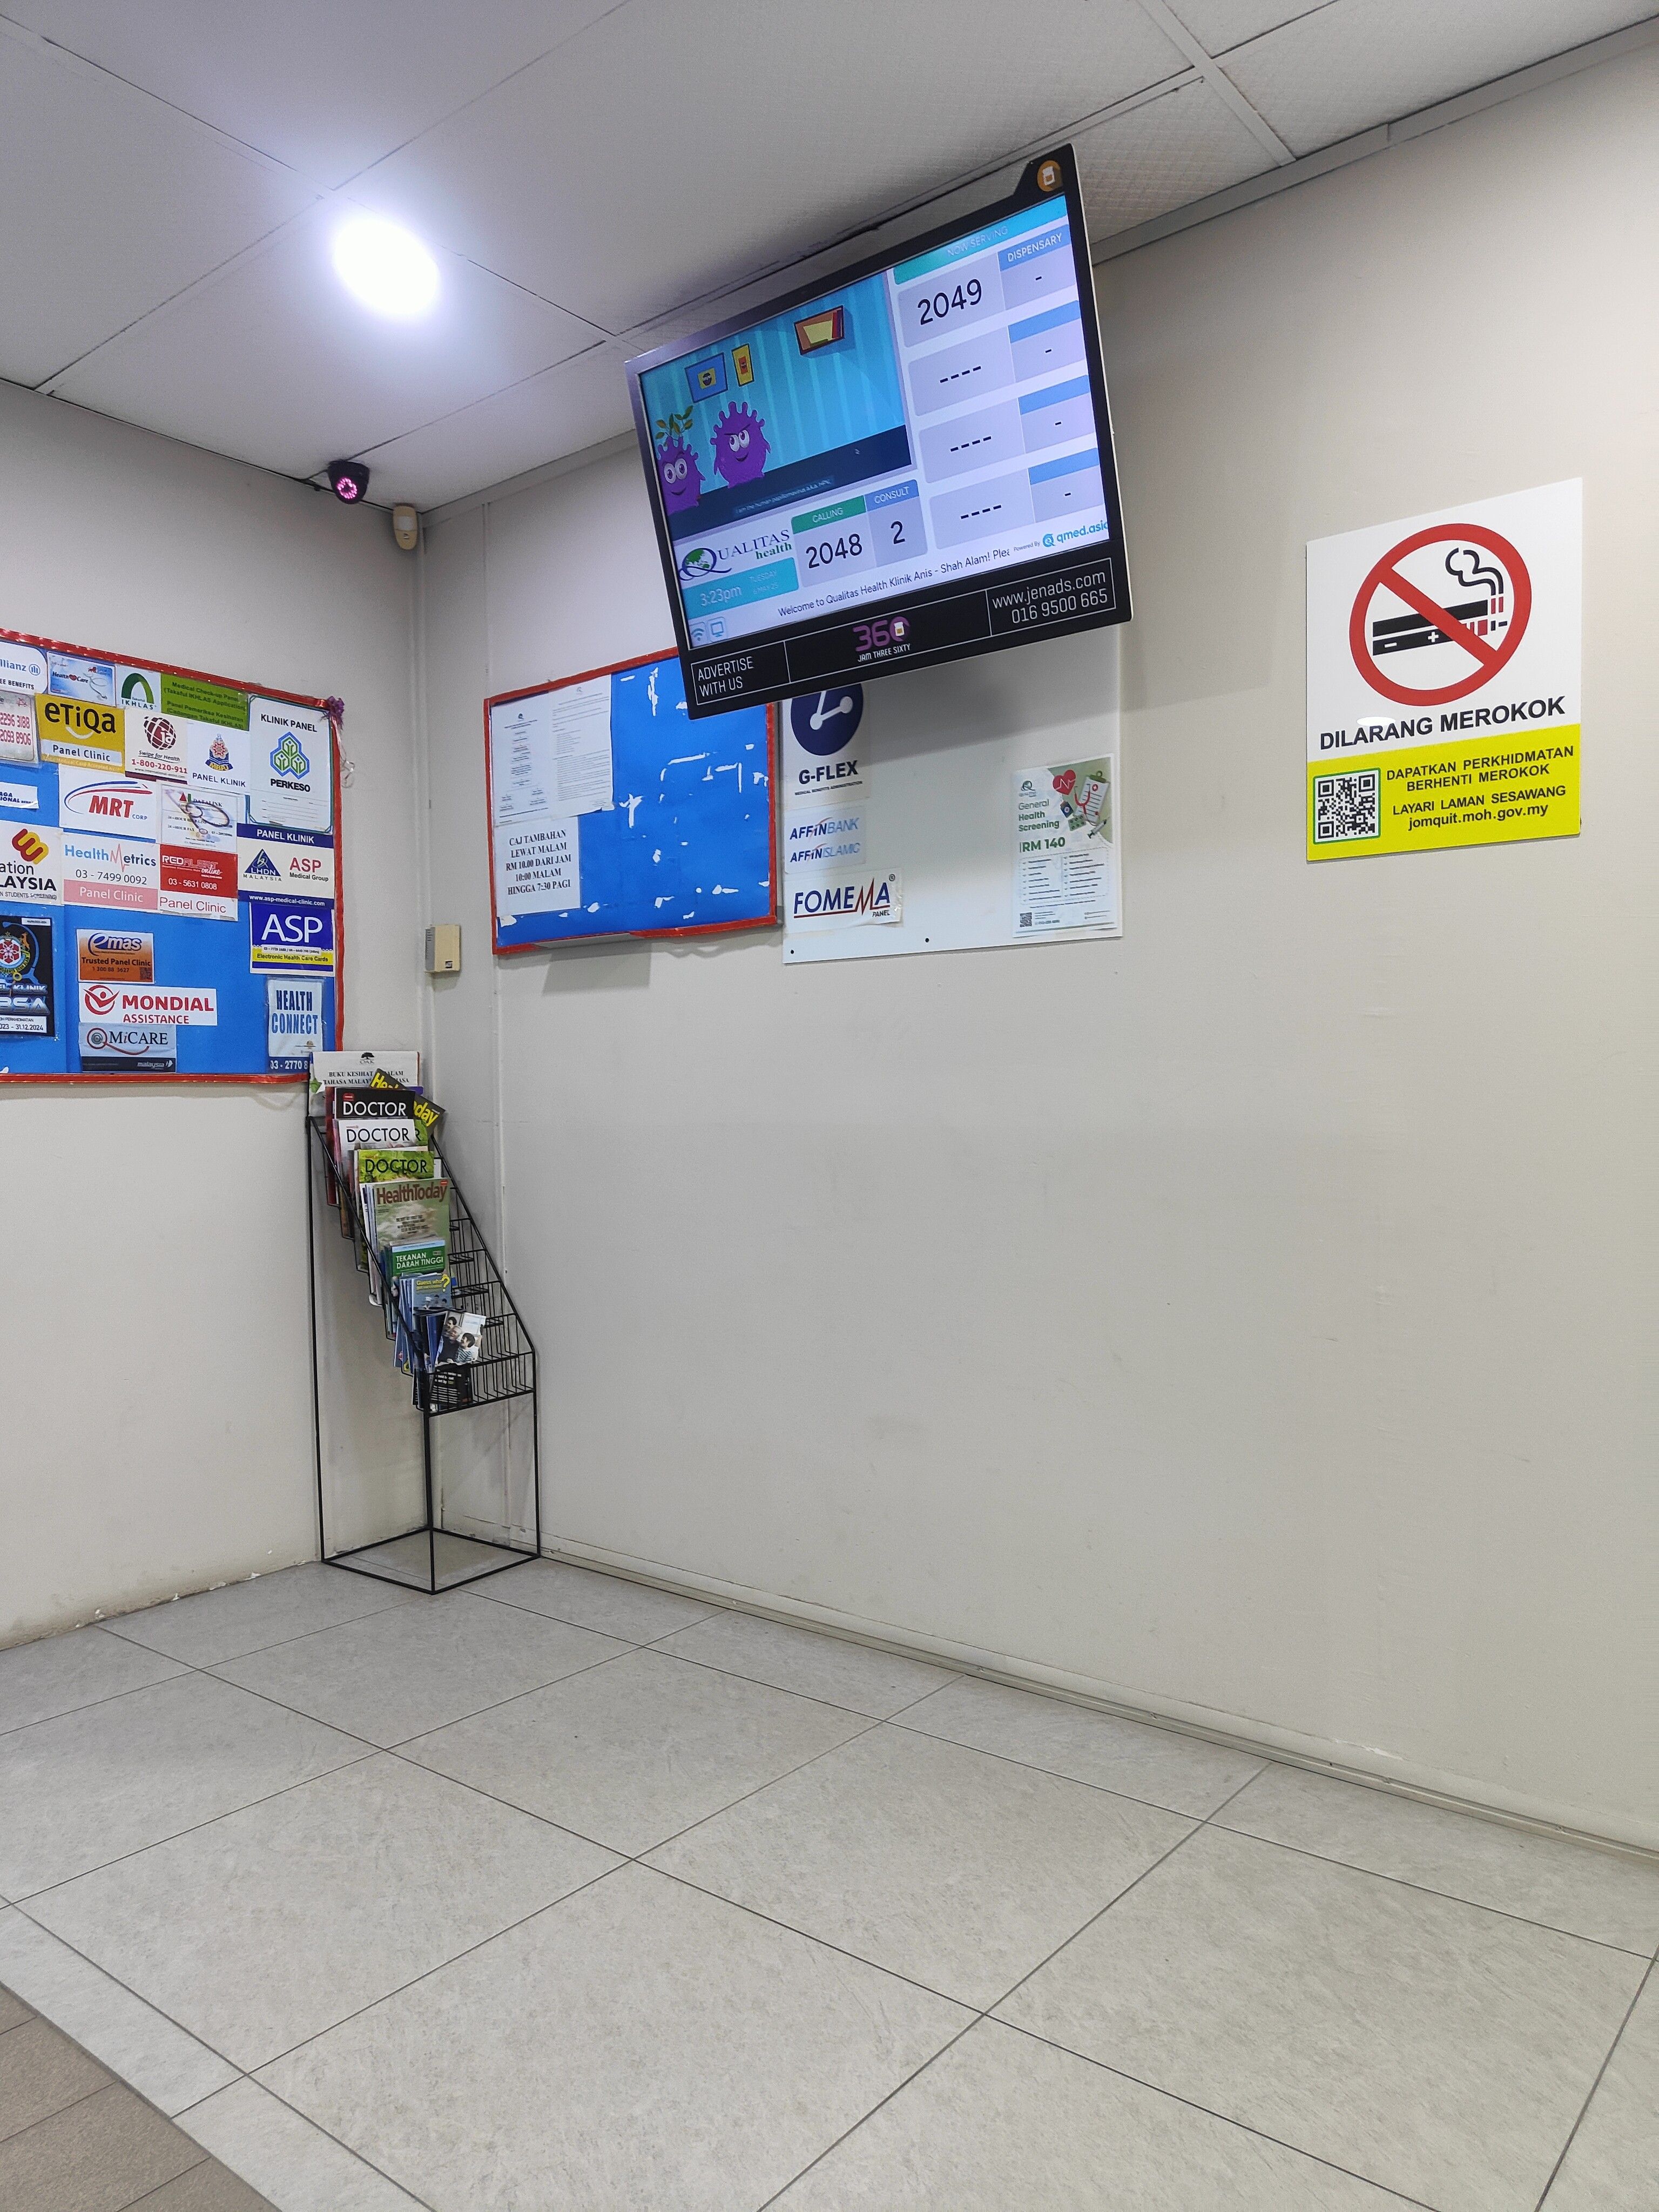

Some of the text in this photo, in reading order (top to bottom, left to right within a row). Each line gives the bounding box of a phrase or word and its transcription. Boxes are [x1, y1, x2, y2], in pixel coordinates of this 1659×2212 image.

[947, 226, 1008, 257] NOW SERVING
[1007, 233, 1062, 263] DISPENSARY
[917, 279, 982, 325] 2049
[874, 486, 910, 504] CONSULT
[812, 507, 843, 524] CALLING
[890, 520, 906, 544] 2
[679, 529, 790, 581] QUALITAS
[756, 542, 792, 559] health
[805, 533, 863, 569] 2048
[777, 552, 990, 617] Welcome to Qualitas Health Klinik Anis Shah Alam!
[992, 569, 1107, 610] www.jenads.com
[700, 585, 742, 608] 3:23pm
[1011, 589, 1108, 625] 016 9500 665
[857, 643, 911, 663] JAM THREE SIXTY
[52, 671, 69, 679] Health
[697, 656, 754, 682] ADVERTISE
[8, 679, 35, 690] BENEFITS
[172, 682, 195, 692] Medical
[699, 676, 743, 698] WITH US
[122, 699, 154, 710] IKHLAS
[166, 700, 184, 709] Panel
[260, 713, 318, 733] KLINIK PANEL
[1320, 695, 1566, 751] DILARANG MEROKOK
[16, 731, 31, 746] 8906
[52, 744, 111, 762] Panel Clinic
[131, 758, 188, 774] 1-800-220-911
[1386, 745, 1574, 781] DAPATKAN PERKHIDMATAN
[192, 772, 219, 783] PANEL
[220, 777, 246, 788] KLINIK
[799, 759, 859, 785] G-FLEX
[1406, 764, 1550, 792] BERHENTI MEROKOK
[270, 778, 312, 793] PERKESO
[88, 795, 134, 819] MRT
[1018, 798, 1050, 811] General
[1392, 785, 1567, 816] LAYARI LAMAN SESAWANG
[1018, 811, 1046, 822] Health
[1407, 803, 1549, 832] jomquit.moh.gov.my
[1018, 820, 1060, 832] Screening
[257, 829, 315, 844] PANEL KLINIK
[509, 829, 567, 846] CAJ TAMBAHAN
[1021, 836, 1066, 853] RM 140
[64, 843, 157, 873] HealthMetrics
[510, 841, 568, 858] LEWAT MALAM
[0, 860, 34, 875] ation
[201, 864, 223, 875] online
[289, 857, 321, 873] ASP
[505, 854, 572, 871] RM 10.00 DARI JAM
[75, 869, 147, 885] 03 7499 0092
[243, 873, 282, 882] MALAYSIA
[251, 867, 276, 876] LHDN
[312, 874, 329, 882] Group
[515, 867, 562, 882] 10:00 MALAM
[168, 878, 218, 891] 03 5631 0808
[508, 879, 571, 895] HINGGA 7:30 PAGI
[79, 886, 144, 903] Panel Clinic
[249, 894, 325, 907] www.asp-medical-clinic.com
[793, 876, 891, 916] FOMEMA
[159, 896, 227, 913] Panel Clinic
[872, 909, 891, 918] PANEL
[261, 913, 323, 943] ASP
[87, 932, 143, 955] emas
[122, 994, 214, 1012] MONDIAL
[276, 990, 313, 1011] HEALTH
[123, 1014, 190, 1024] ASSISTANCE
[271, 1013, 319, 1035] CONNECT
[109, 1030, 168, 1045] MiCARE
[269, 1060, 302, 1070] 03 2770
[343, 1101, 407, 1116] DOCTOR
[346, 1128, 410, 1143] DOCTOR
[365, 1159, 428, 1174] DOCTOR
[376, 1181, 448, 1205] HealthToday
[396, 1252, 427, 1263] TEKANAN
[396, 1257, 443, 1269] DARAH TINGGI
